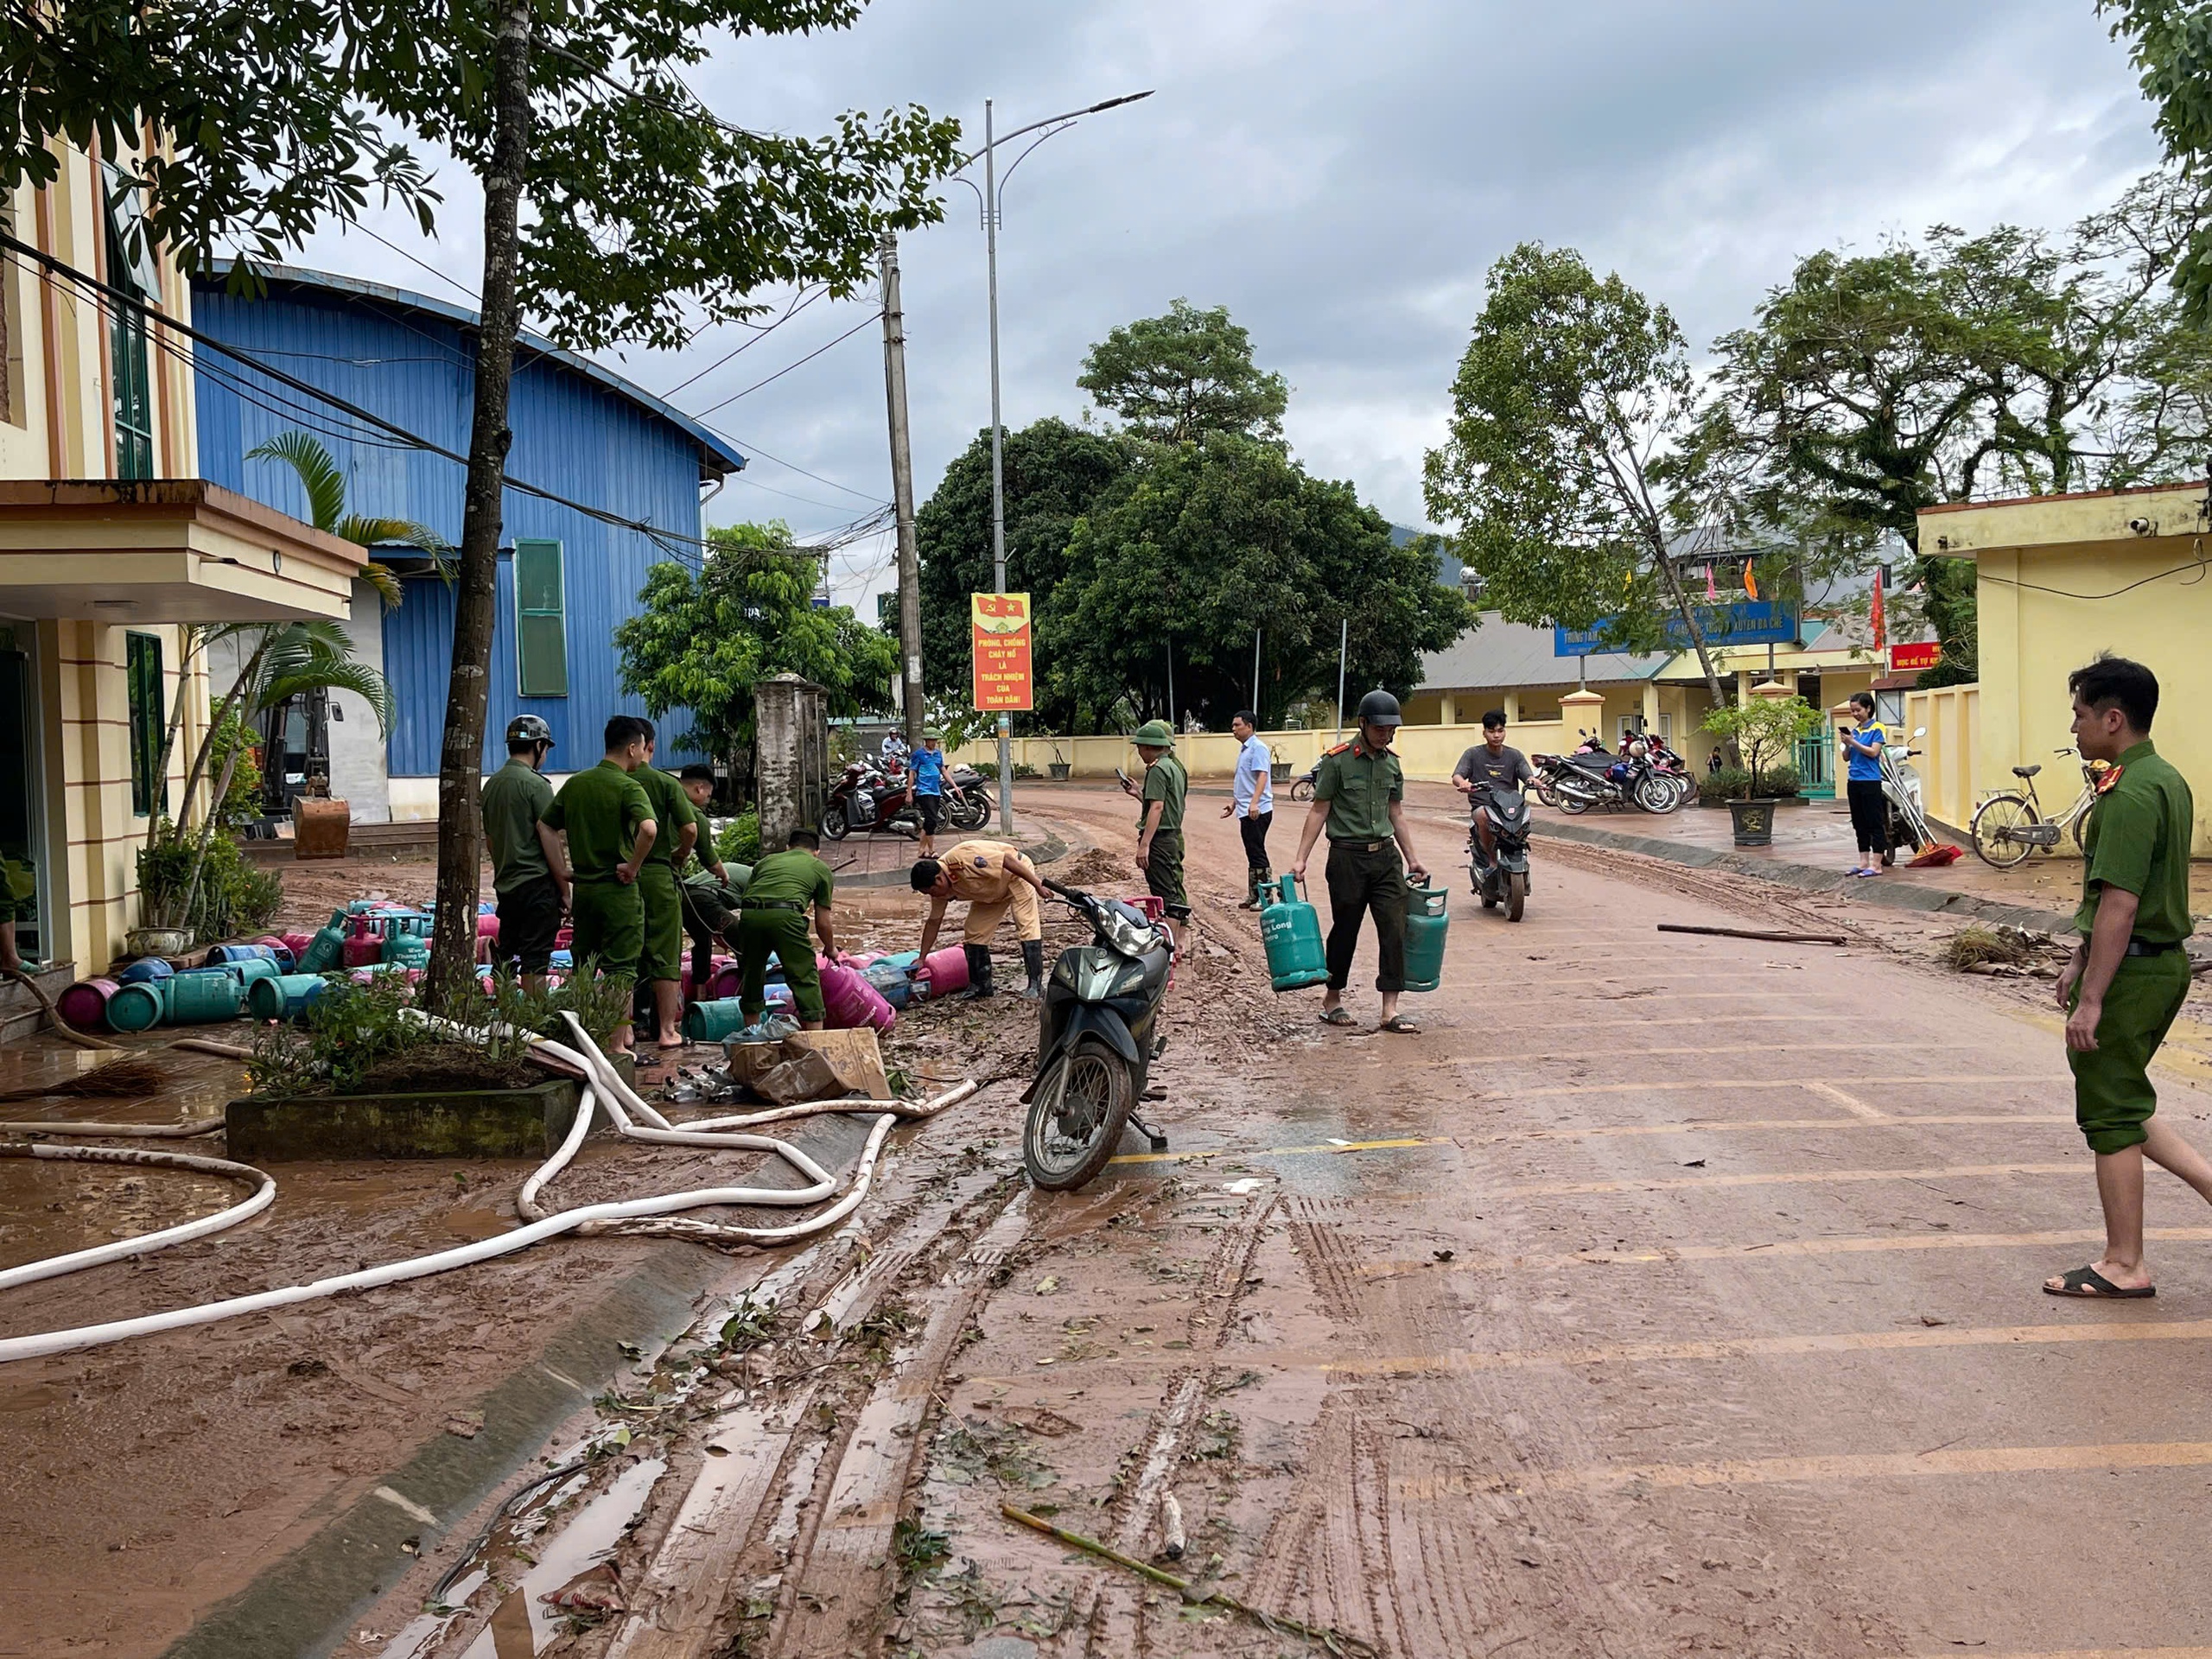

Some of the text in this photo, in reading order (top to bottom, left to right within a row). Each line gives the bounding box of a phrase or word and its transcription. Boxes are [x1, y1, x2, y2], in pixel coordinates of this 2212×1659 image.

[988, 650, 1006, 658] CHÁY
[982, 672, 1002, 681] TRÁCH
[1271, 921, 1292, 931] Long
